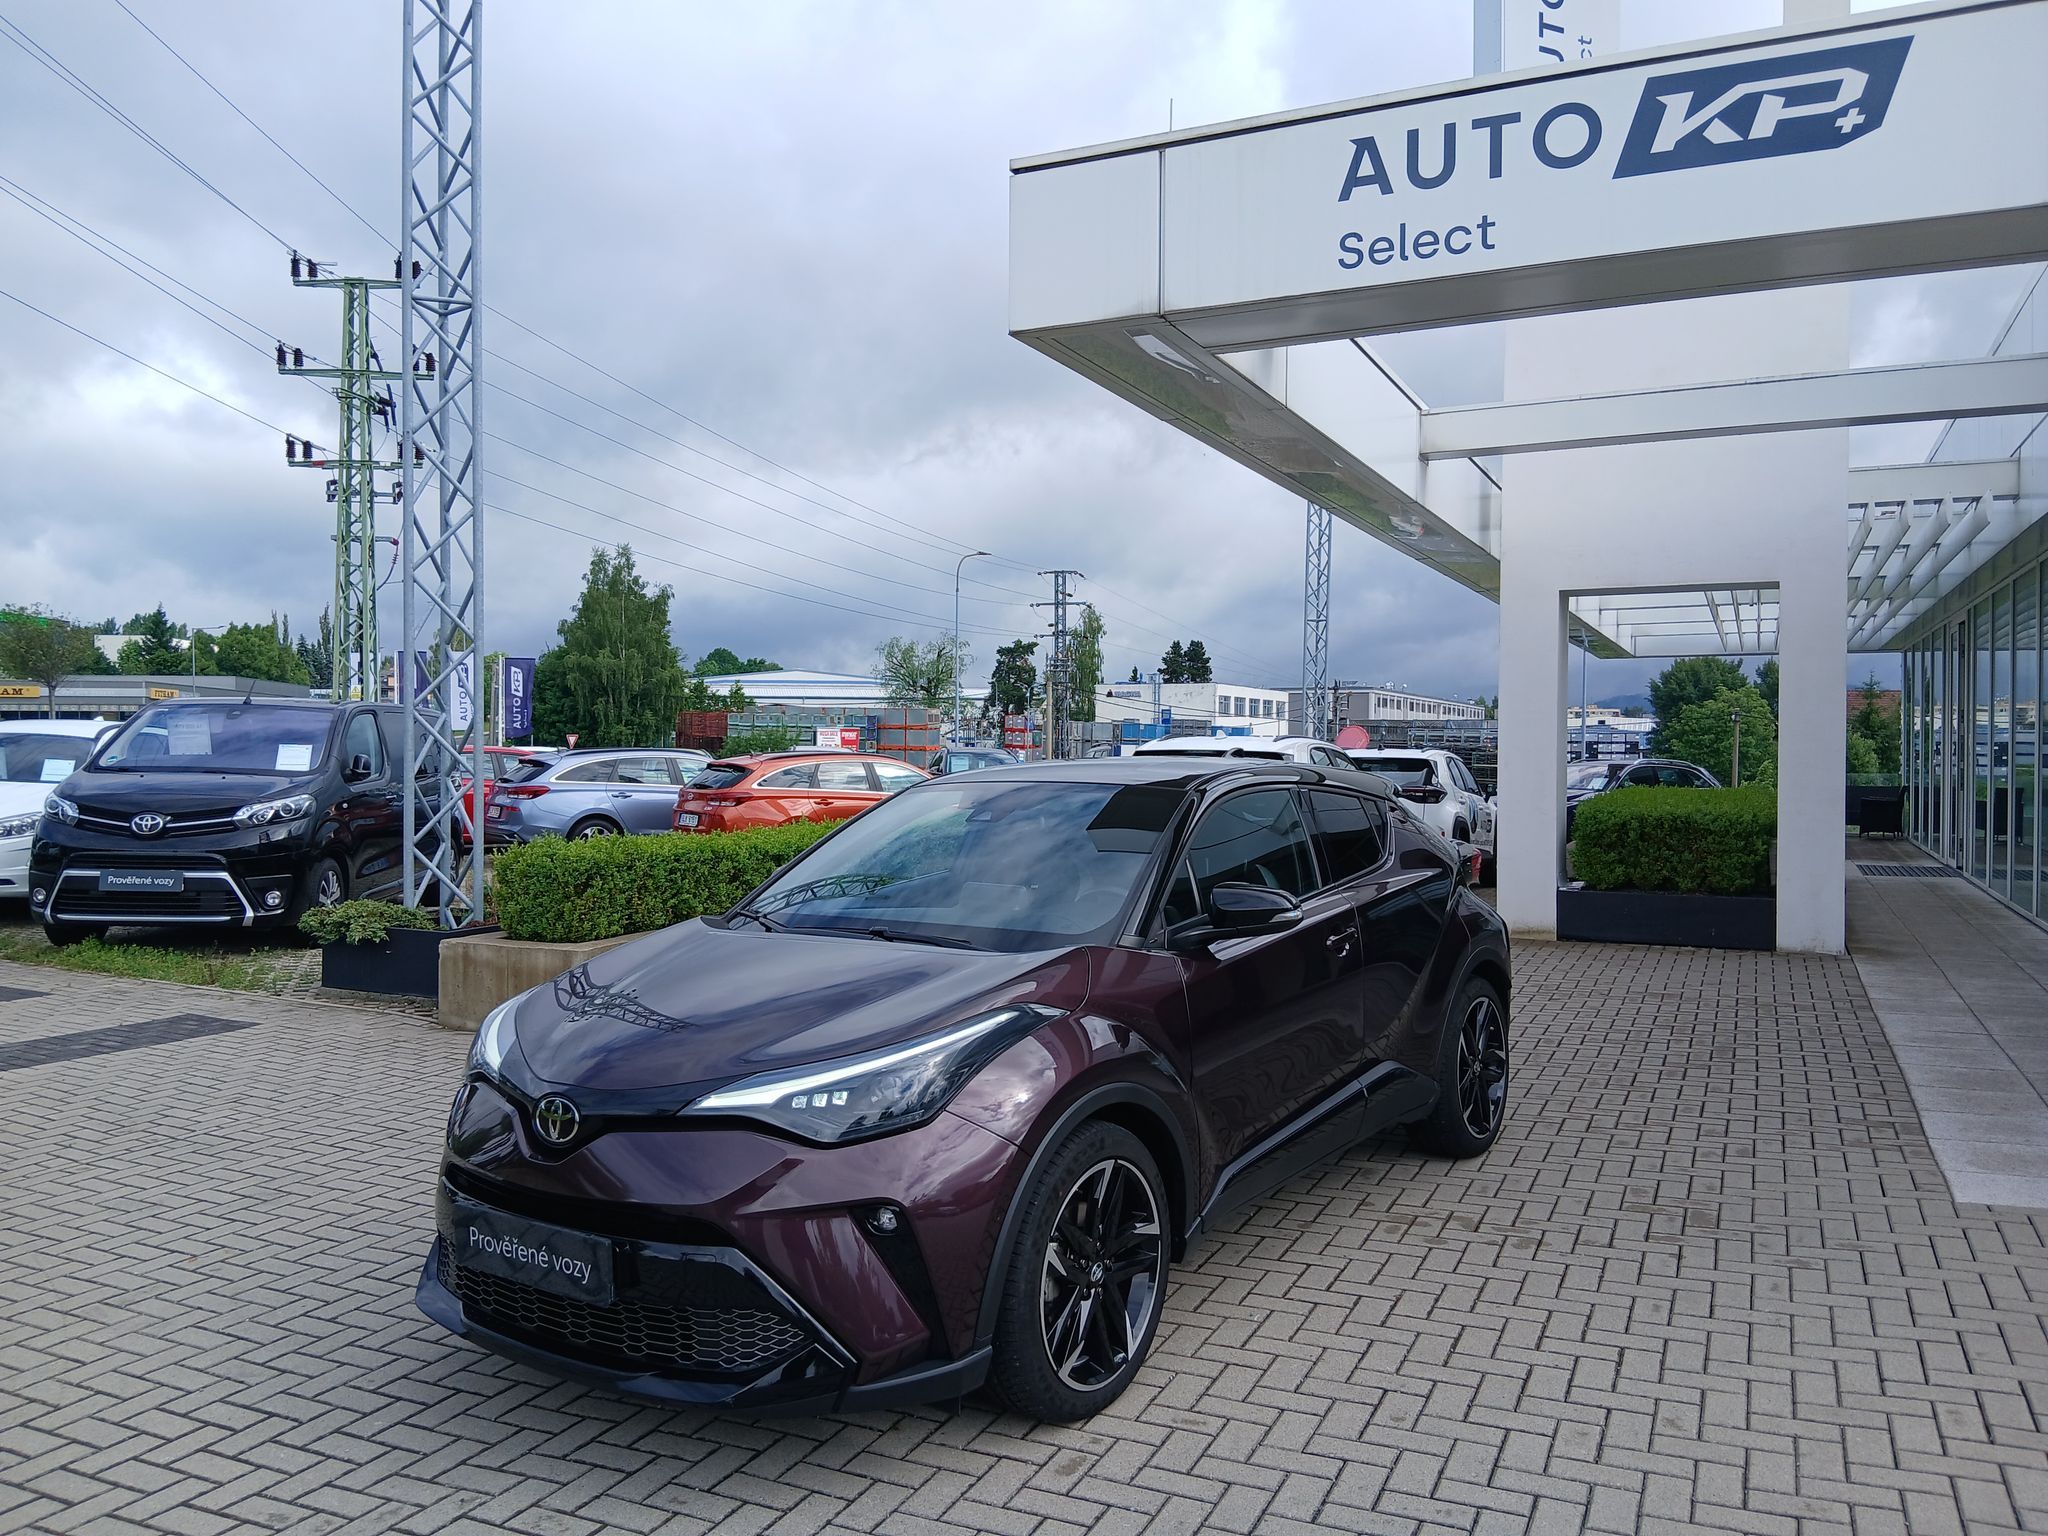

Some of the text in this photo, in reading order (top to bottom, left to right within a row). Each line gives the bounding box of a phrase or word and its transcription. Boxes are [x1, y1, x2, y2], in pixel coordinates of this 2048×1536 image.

[1338, 101, 1602, 202] AUTO
[1337, 214, 1496, 270] Select
[459, 691, 468, 722] AUTO
[513, 697, 522, 729] AUTO
[107, 875, 175, 887] Prověřené vozy
[469, 1226, 591, 1284] Prověřené vozy
